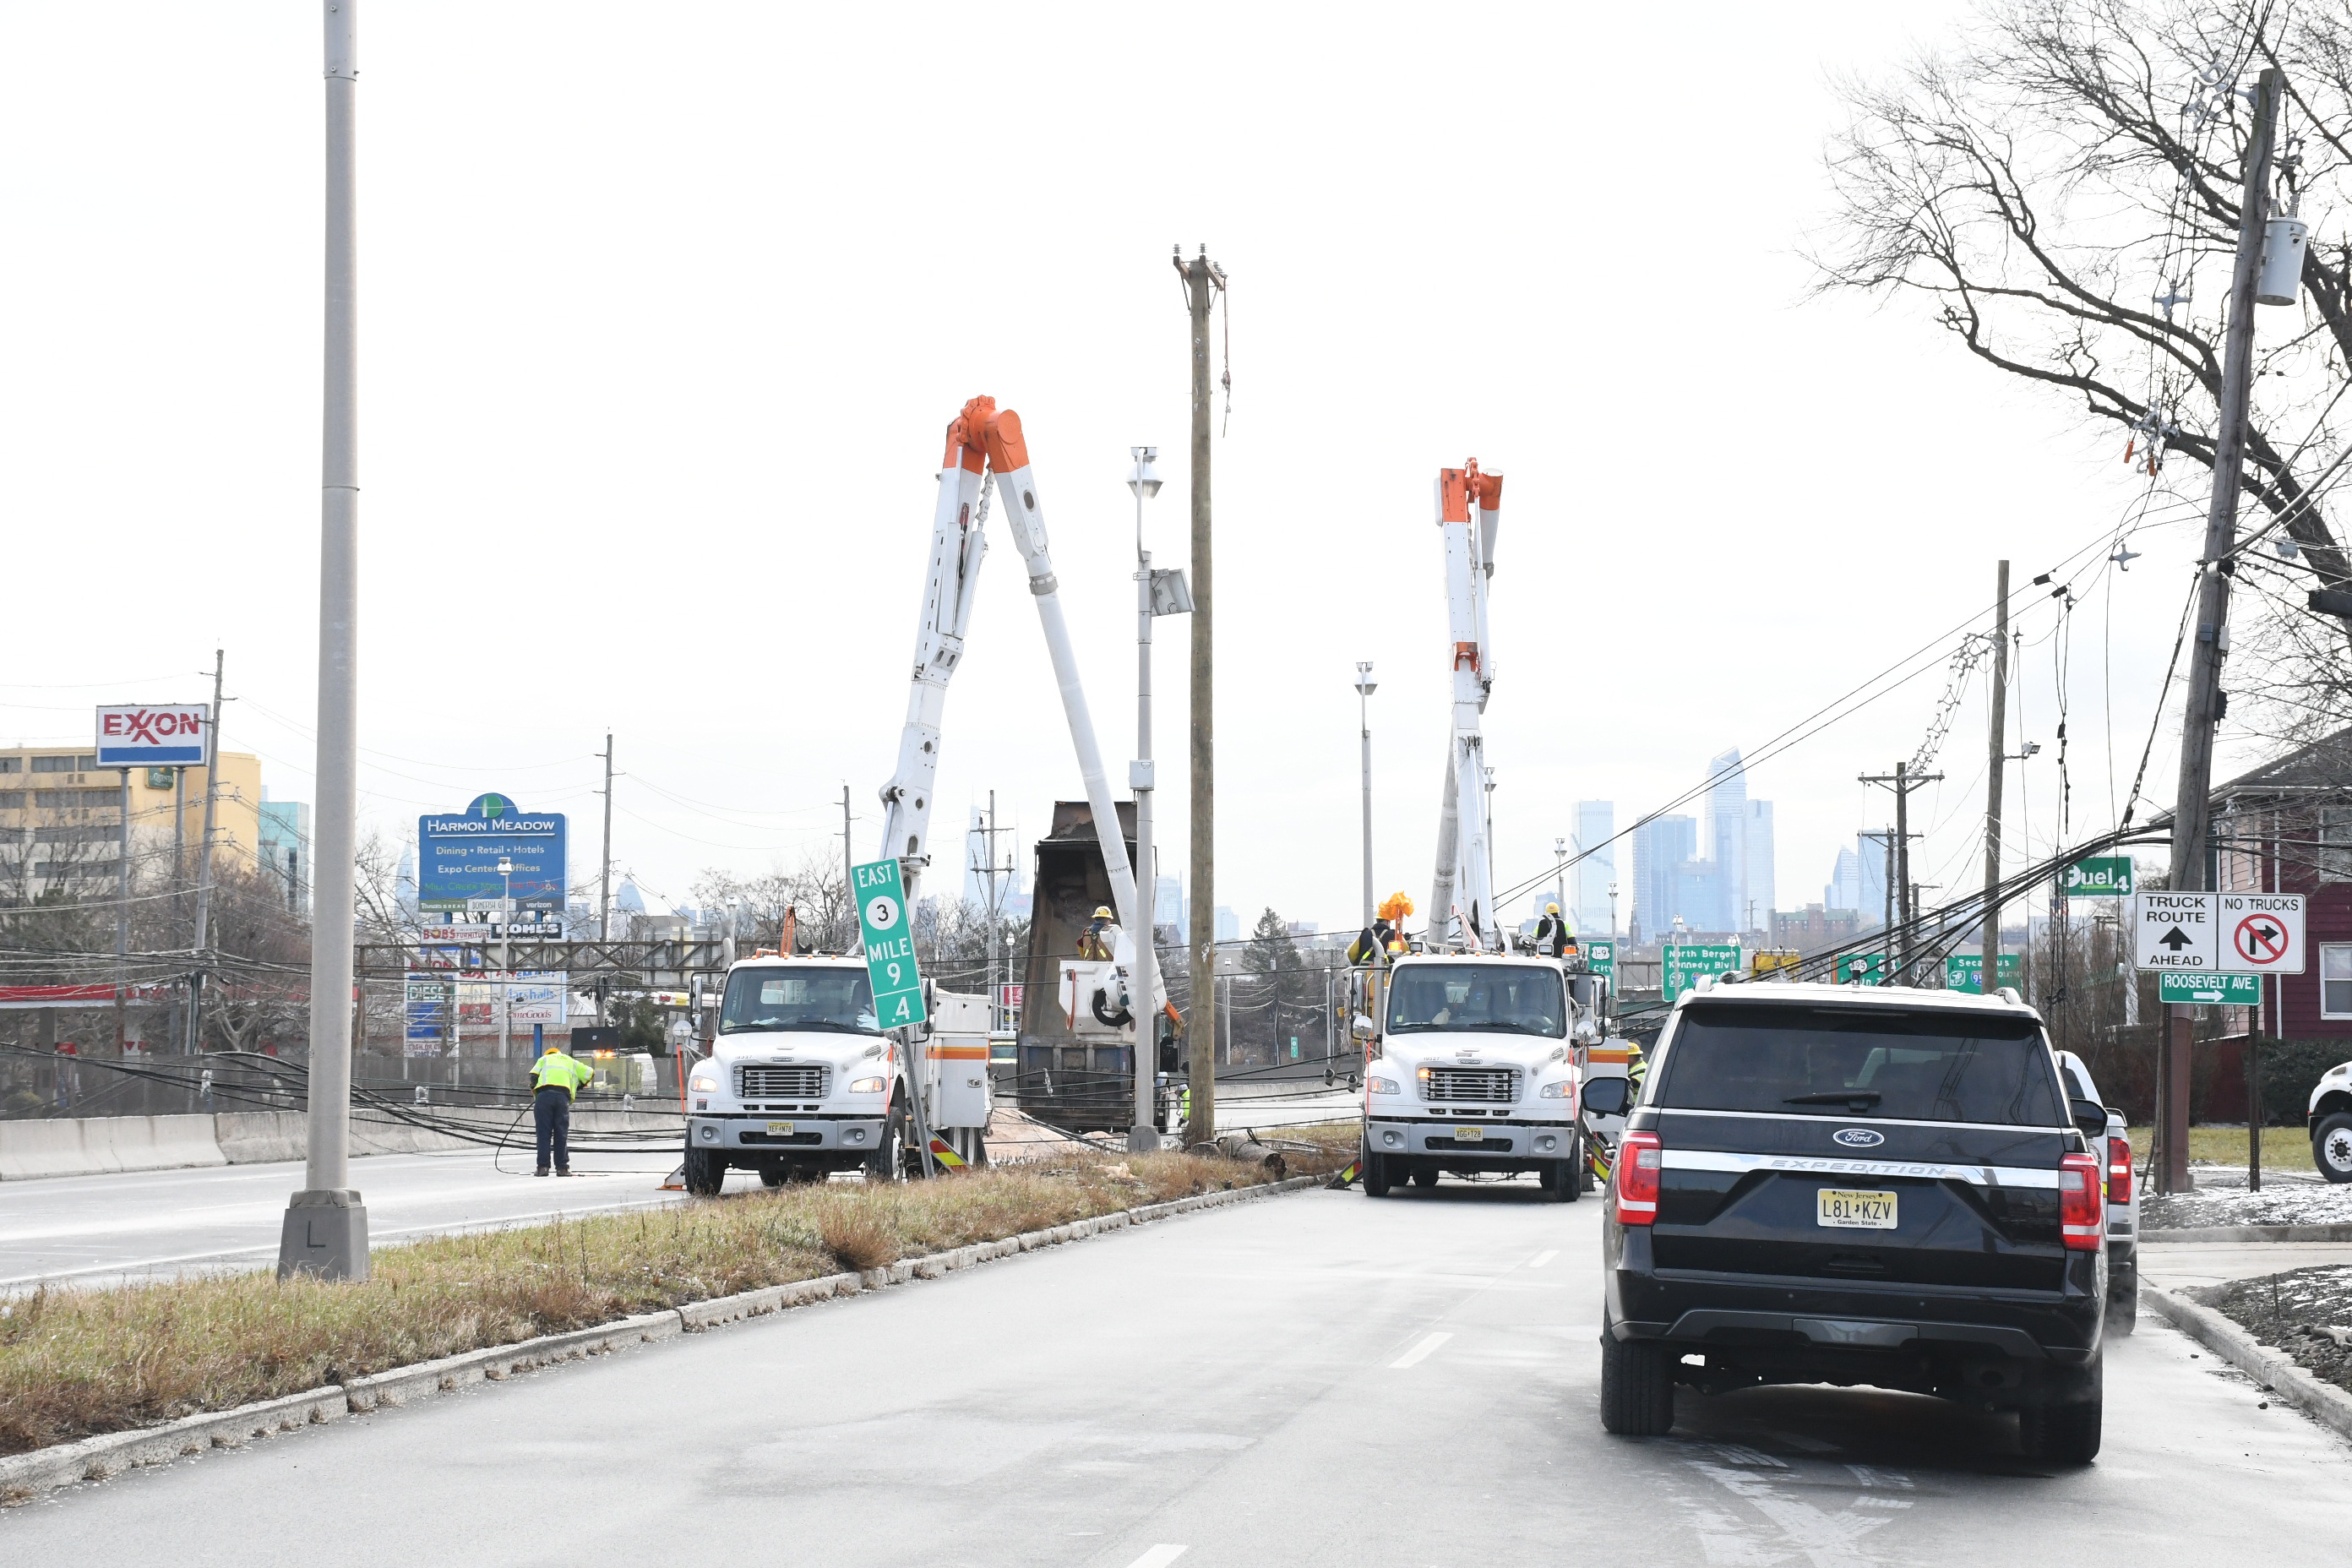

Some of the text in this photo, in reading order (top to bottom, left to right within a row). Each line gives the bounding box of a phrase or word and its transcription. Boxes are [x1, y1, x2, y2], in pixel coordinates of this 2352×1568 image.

[104, 710, 199, 744] EXXON
[427, 819, 555, 832] HARMON MEADOW
[436, 845, 545, 857] Dining Retail Hotels
[438, 865, 462, 875] Expo
[857, 863, 892, 888] EAST
[2146, 896, 2207, 909] TRUCK
[2224, 898, 2300, 912] NO TRUCKS
[876, 904, 889, 922] 3
[2146, 911, 2206, 923] ROUTE
[868, 937, 911, 963] MILE
[1594, 949, 1608, 957] 1-9
[1701, 949, 1736, 961] Bergen
[1957, 959, 2011, 967] Secaus
[2149, 955, 2203, 966] AHEAD
[886, 962, 901, 987] 9
[2164, 976, 2256, 990] ROOSEVELT AVE.
[409, 985, 447, 1000] DIESE
[1845, 1131, 1873, 1143] Ford
[1771, 1159, 1946, 1176] EXPEDITION
[1855, 1192, 1877, 1200] Jersey
[1823, 1199, 1892, 1220] L81 KZV
[307, 1221, 326, 1248] L
